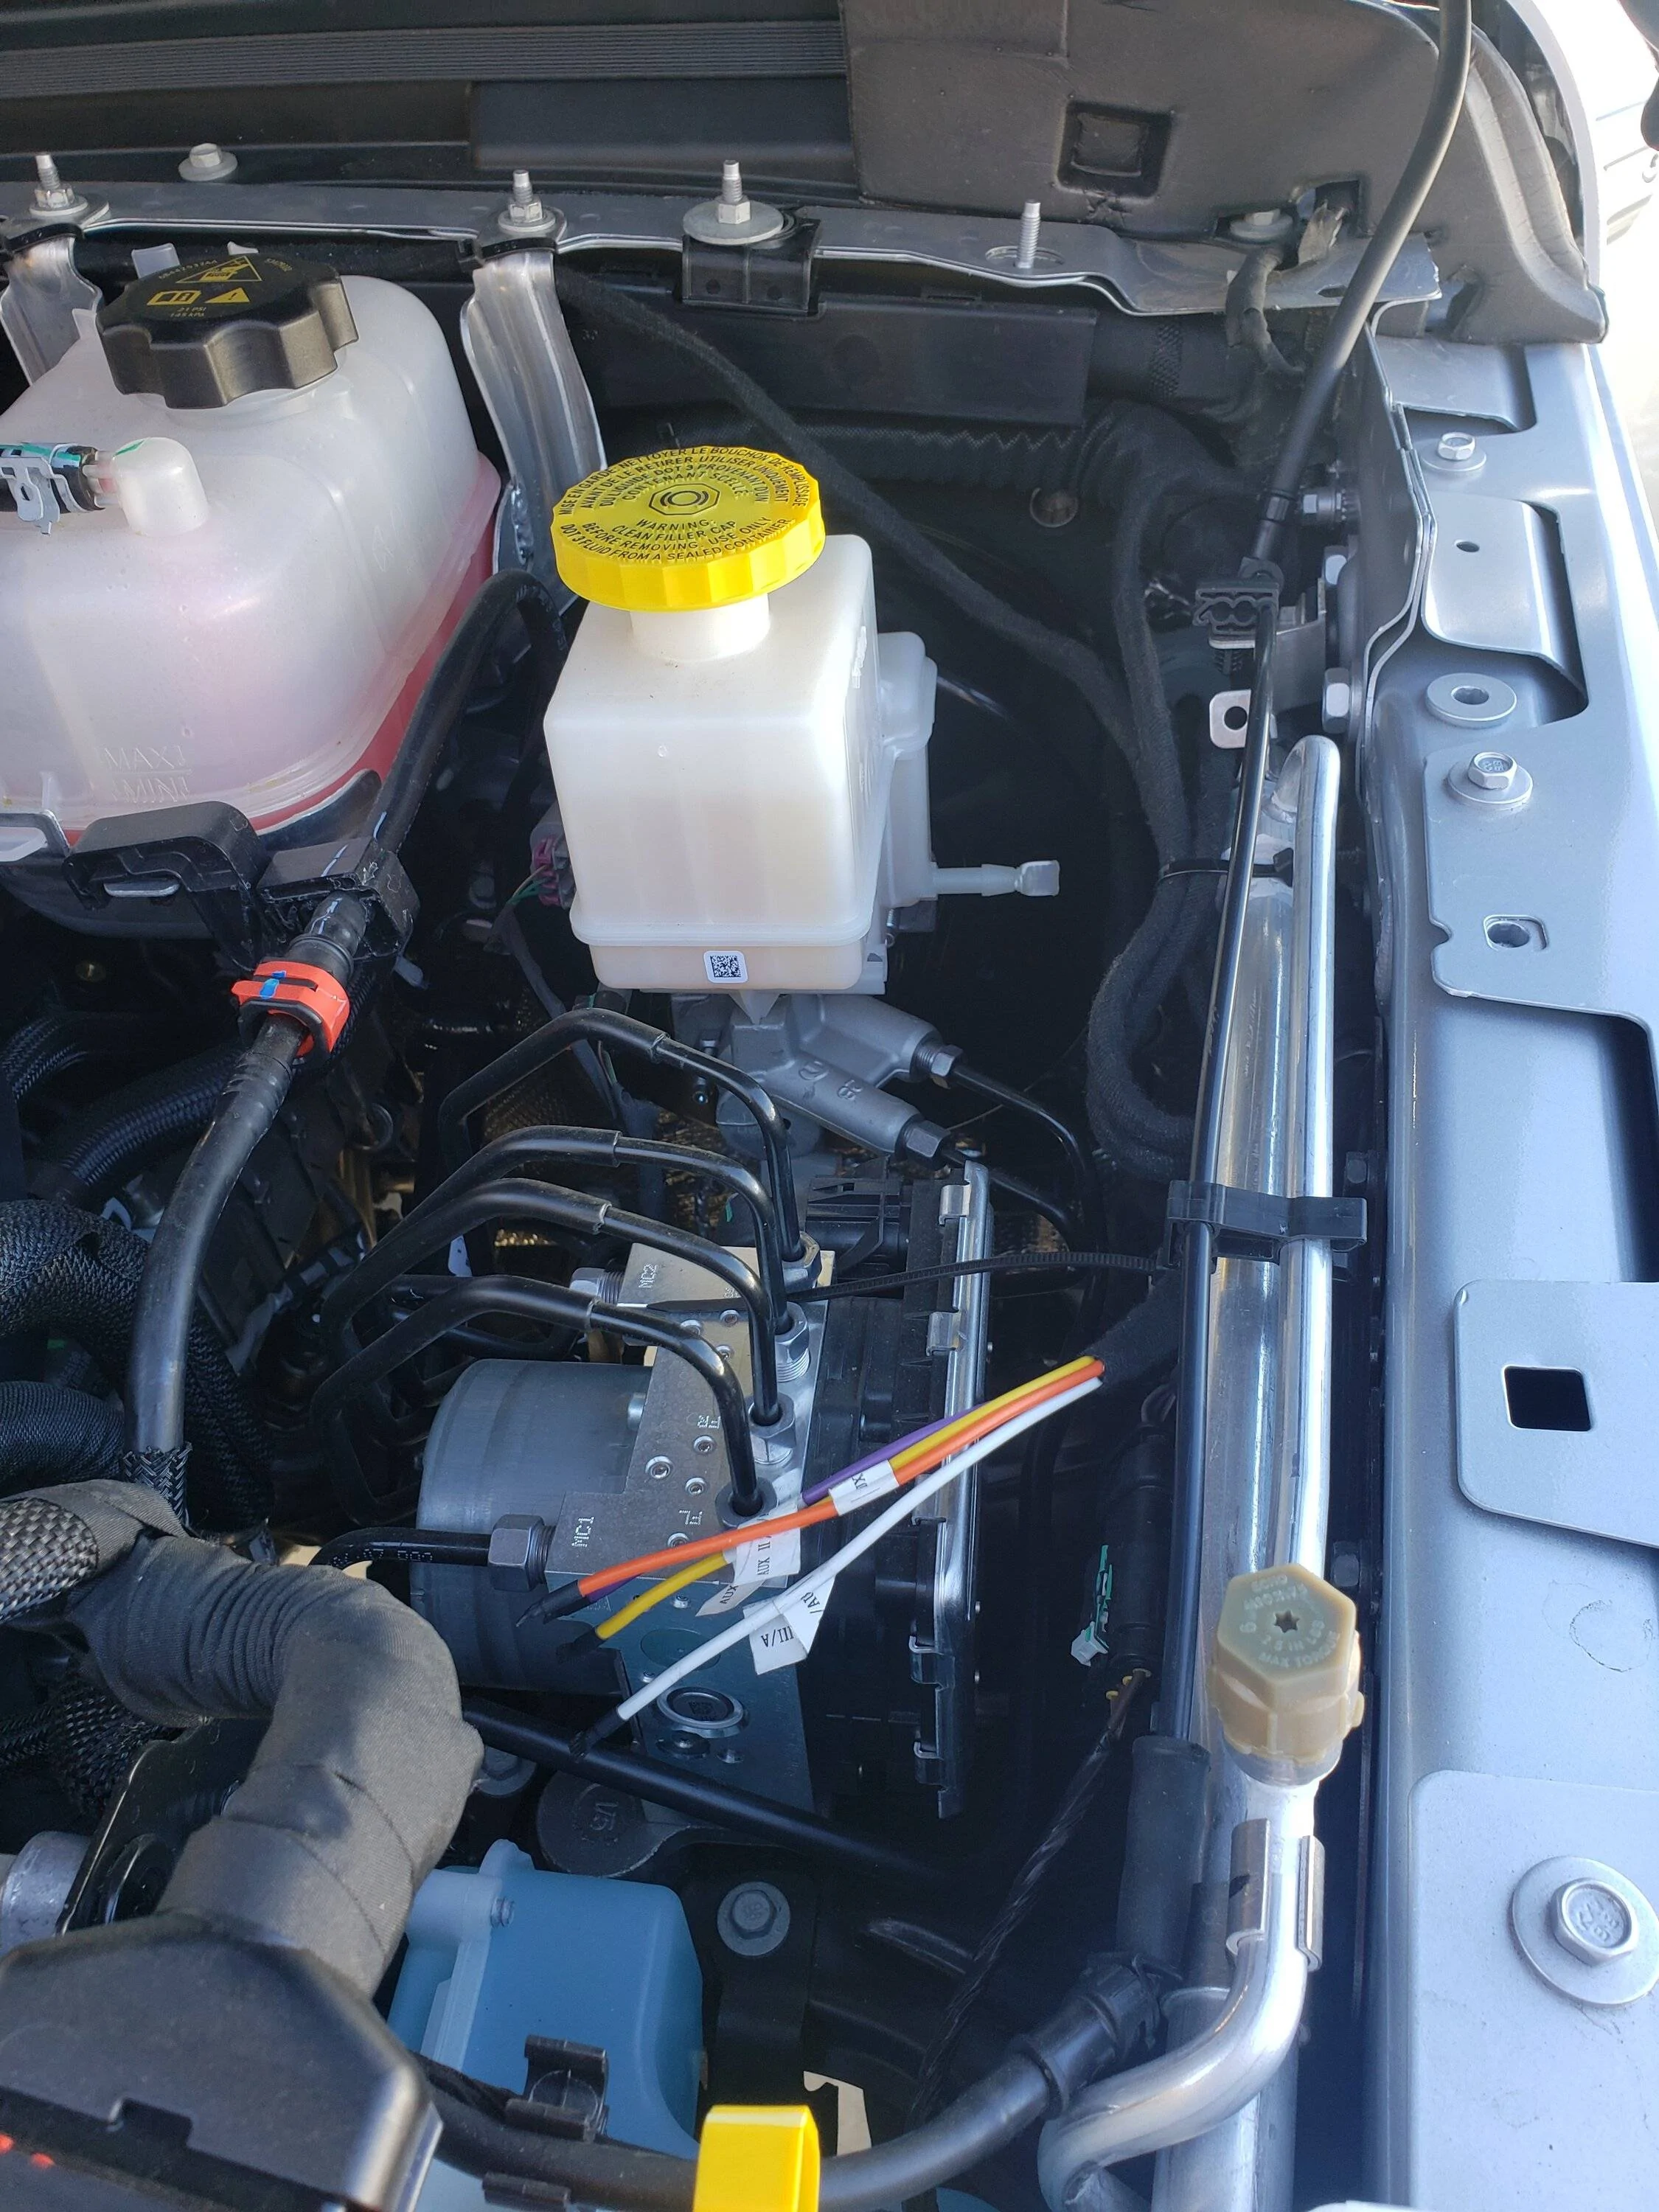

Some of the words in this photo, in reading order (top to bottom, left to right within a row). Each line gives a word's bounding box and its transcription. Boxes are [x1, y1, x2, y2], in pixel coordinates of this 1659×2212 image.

[618, 448, 686, 468] NETTOYER
[710, 447, 770, 461] BOUCHON
[768, 458, 787, 467] DE
[580, 487, 605, 508] AVANT
[600, 479, 619, 487] DE
[616, 470, 635, 479] LE
[699, 456, 755, 467] UTILISER
[753, 465, 790, 501] UNIQUEMENT
[599, 497, 616, 507] DU
[608, 473, 650, 496] LIQUIDE
[654, 466, 681, 476] DOT
[698, 464, 765, 485] PROVENANT
[622, 472, 706, 500] CONTENANT
[782, 465, 810, 507] REMPLISSAGE
[567, 490, 585, 498] EN
[559, 499, 577, 515] MISE
[560, 524, 581, 537] DOT
[578, 540, 611, 554] FLUID
[608, 549, 650, 560] FROM
[667, 547, 722, 560] SEALED
[724, 519, 792, 550] CONTAINER
[582, 523, 622, 544] BEFORE
[709, 532, 738, 545] USE
[740, 517, 771, 534] ONLY
[612, 525, 653, 540] CLEAN
[655, 531, 706, 540] FILLER
[710, 521, 736, 534] CAP
[757, 1557, 771, 1576] AUX
[719, 1585, 739, 1605] AUX
